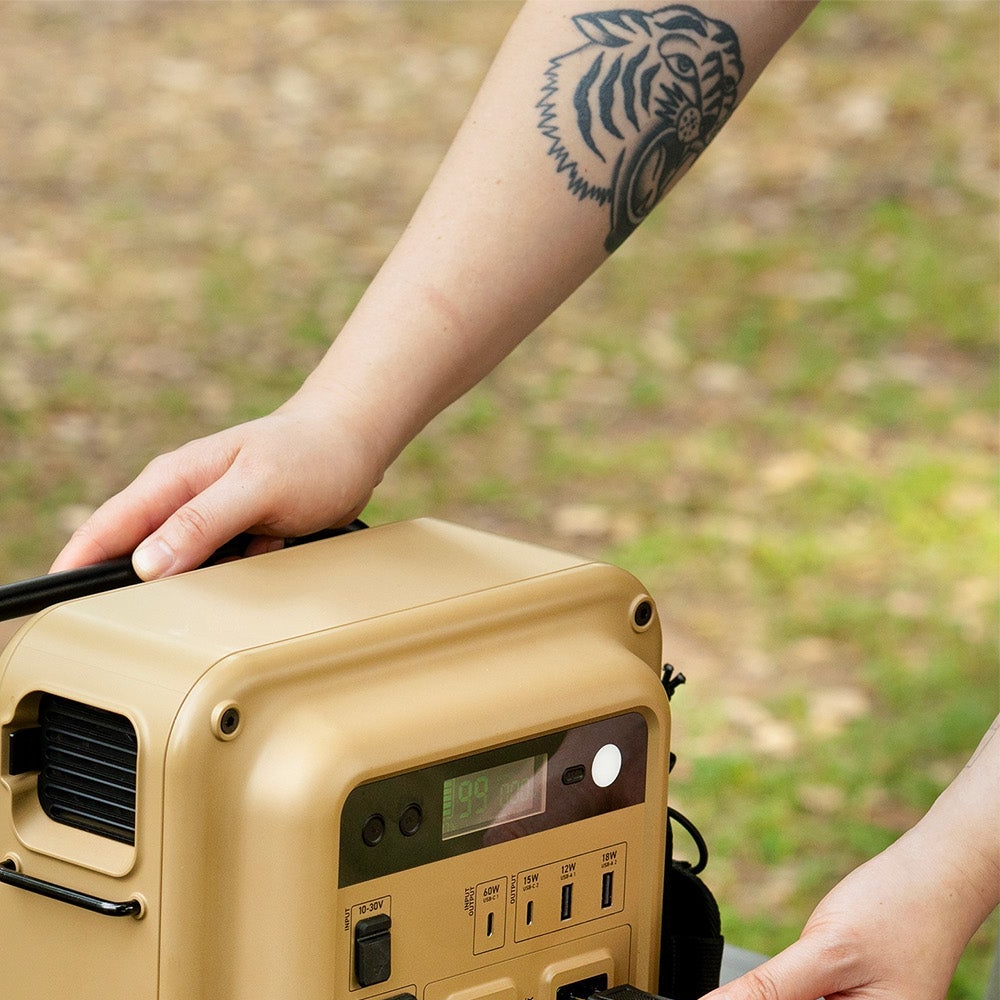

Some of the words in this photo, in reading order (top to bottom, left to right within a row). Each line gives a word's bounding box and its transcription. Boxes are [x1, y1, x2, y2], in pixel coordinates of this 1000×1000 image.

[458, 776, 489, 819] 99
[602, 850, 618, 862] 18W
[561, 862, 576, 875] 12W
[523, 873, 539, 885] 15W
[483, 884, 500, 897] 60W
[358, 900, 384, 915] 10-30V
